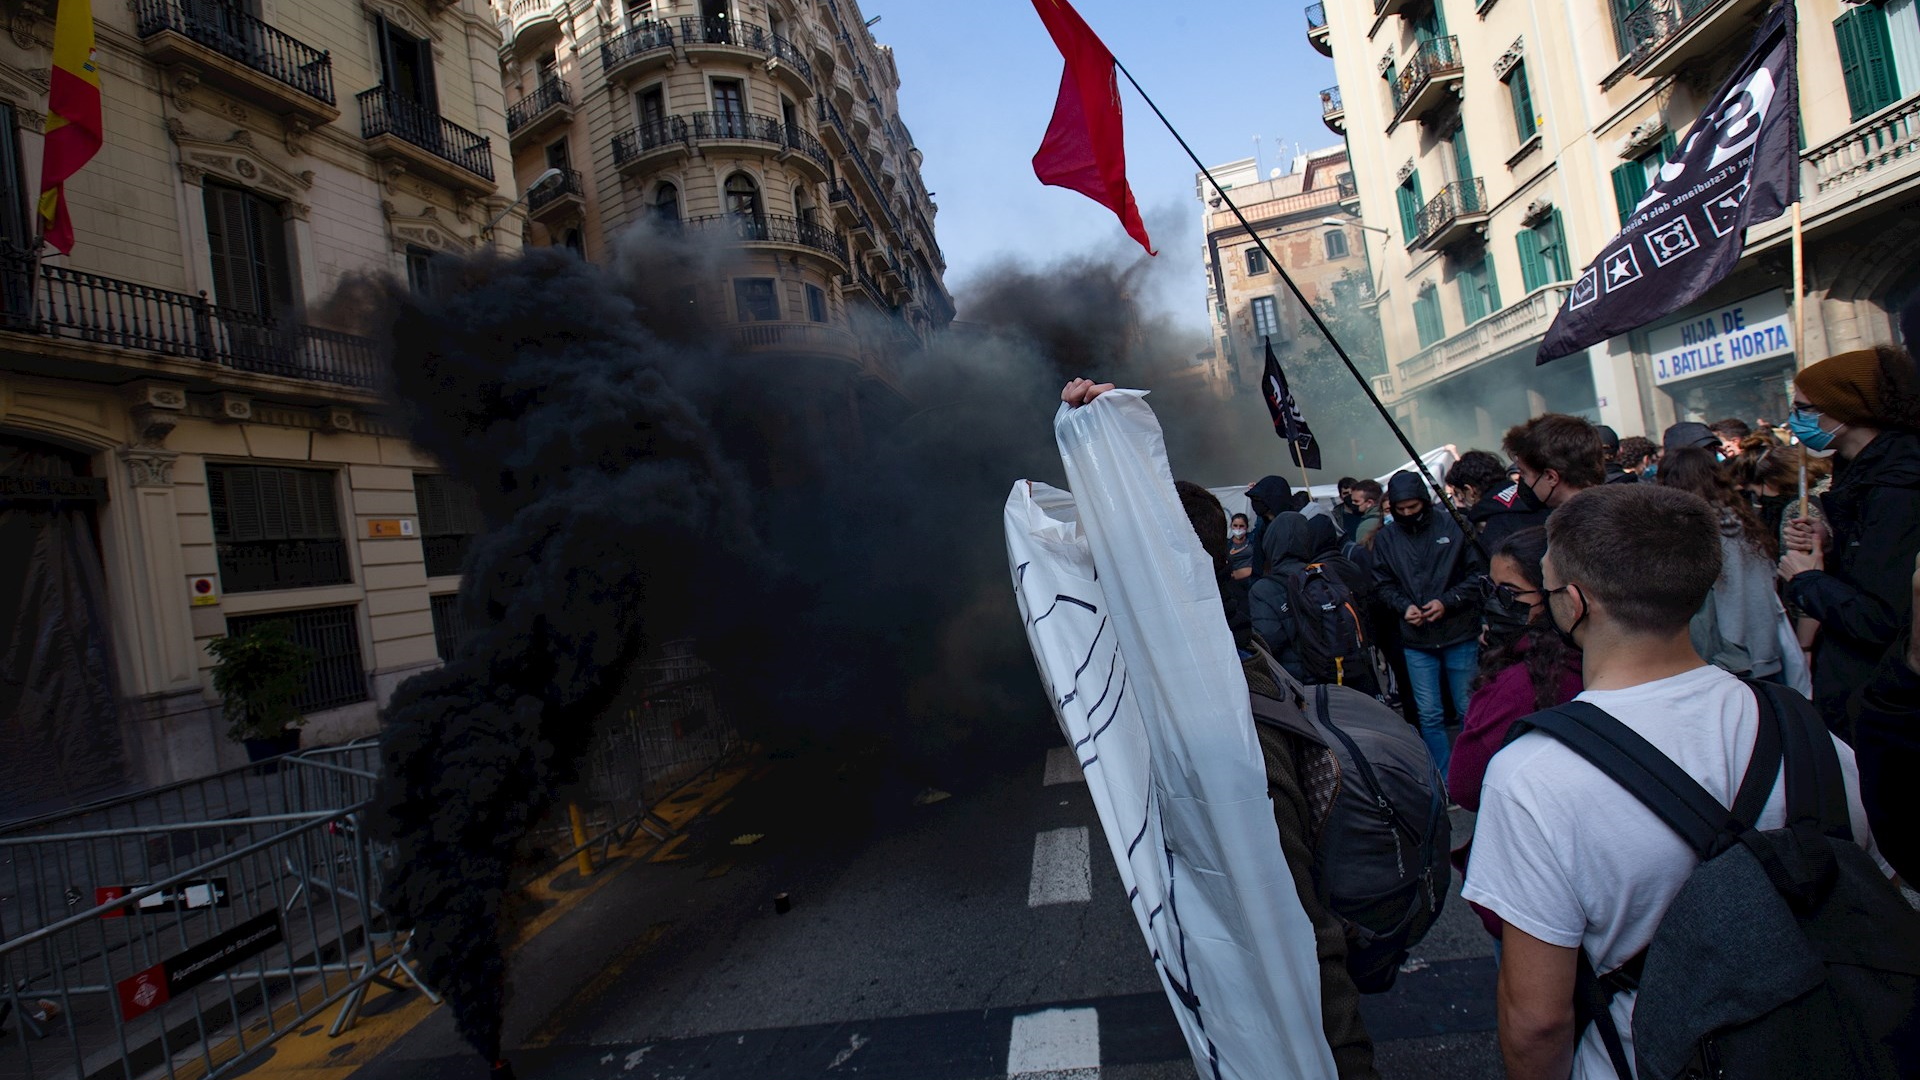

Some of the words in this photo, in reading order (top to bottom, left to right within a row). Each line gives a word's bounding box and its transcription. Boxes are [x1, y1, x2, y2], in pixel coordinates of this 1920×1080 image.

[1681, 317, 1717, 347] HIJA
[1721, 307, 1745, 335] DE
[1658, 359, 1670, 379] J.
[1672, 342, 1725, 376] BATLLE
[1729, 324, 1789, 361] HORTA
